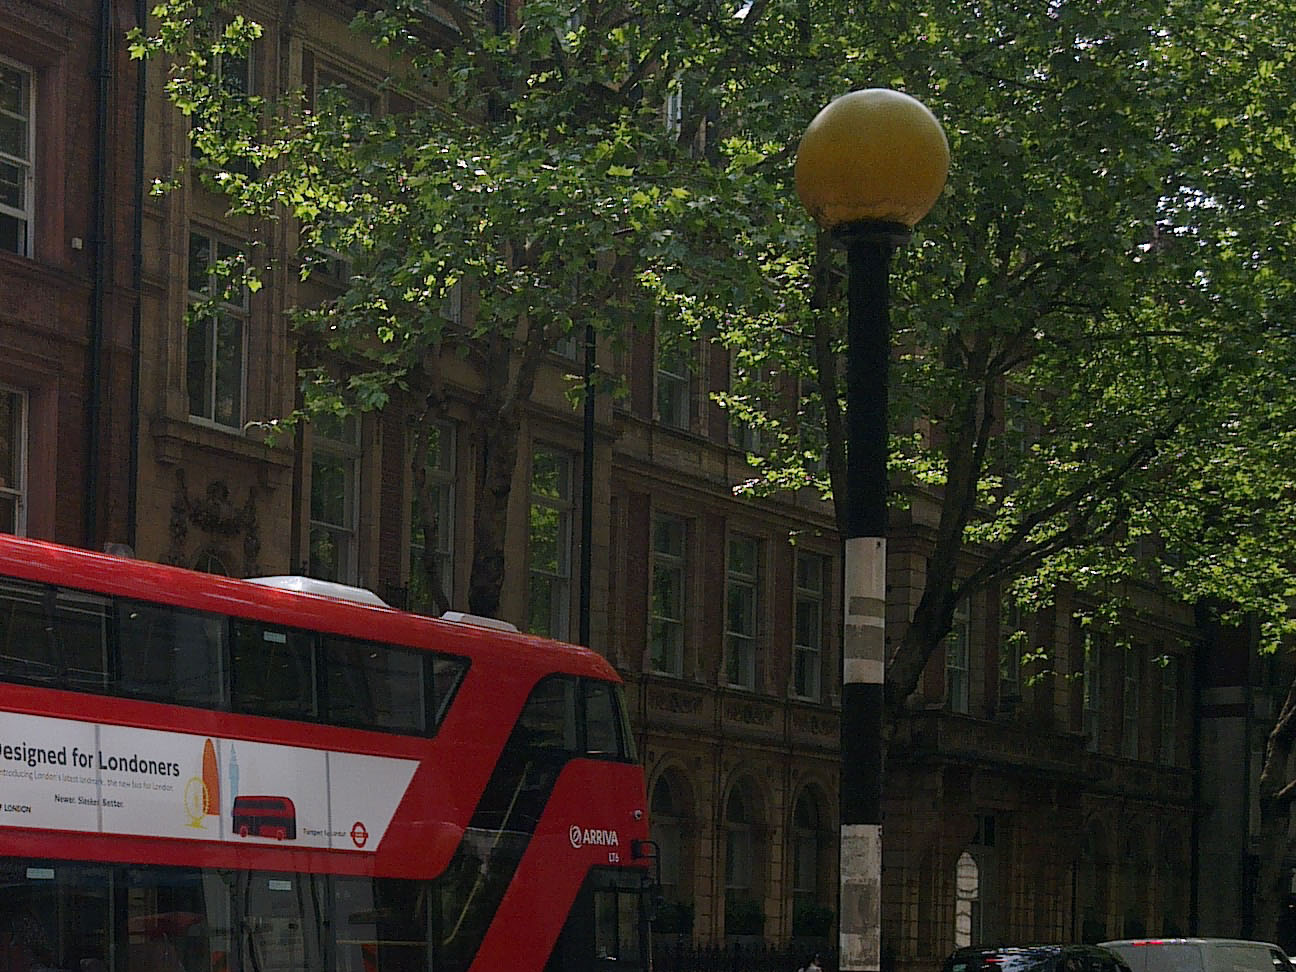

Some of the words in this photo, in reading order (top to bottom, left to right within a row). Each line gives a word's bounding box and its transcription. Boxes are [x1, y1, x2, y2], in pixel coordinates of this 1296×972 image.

[72, 747, 93, 768] for
[98, 750, 180, 777] Londoners
[583, 829, 619, 846] ARRIVA
